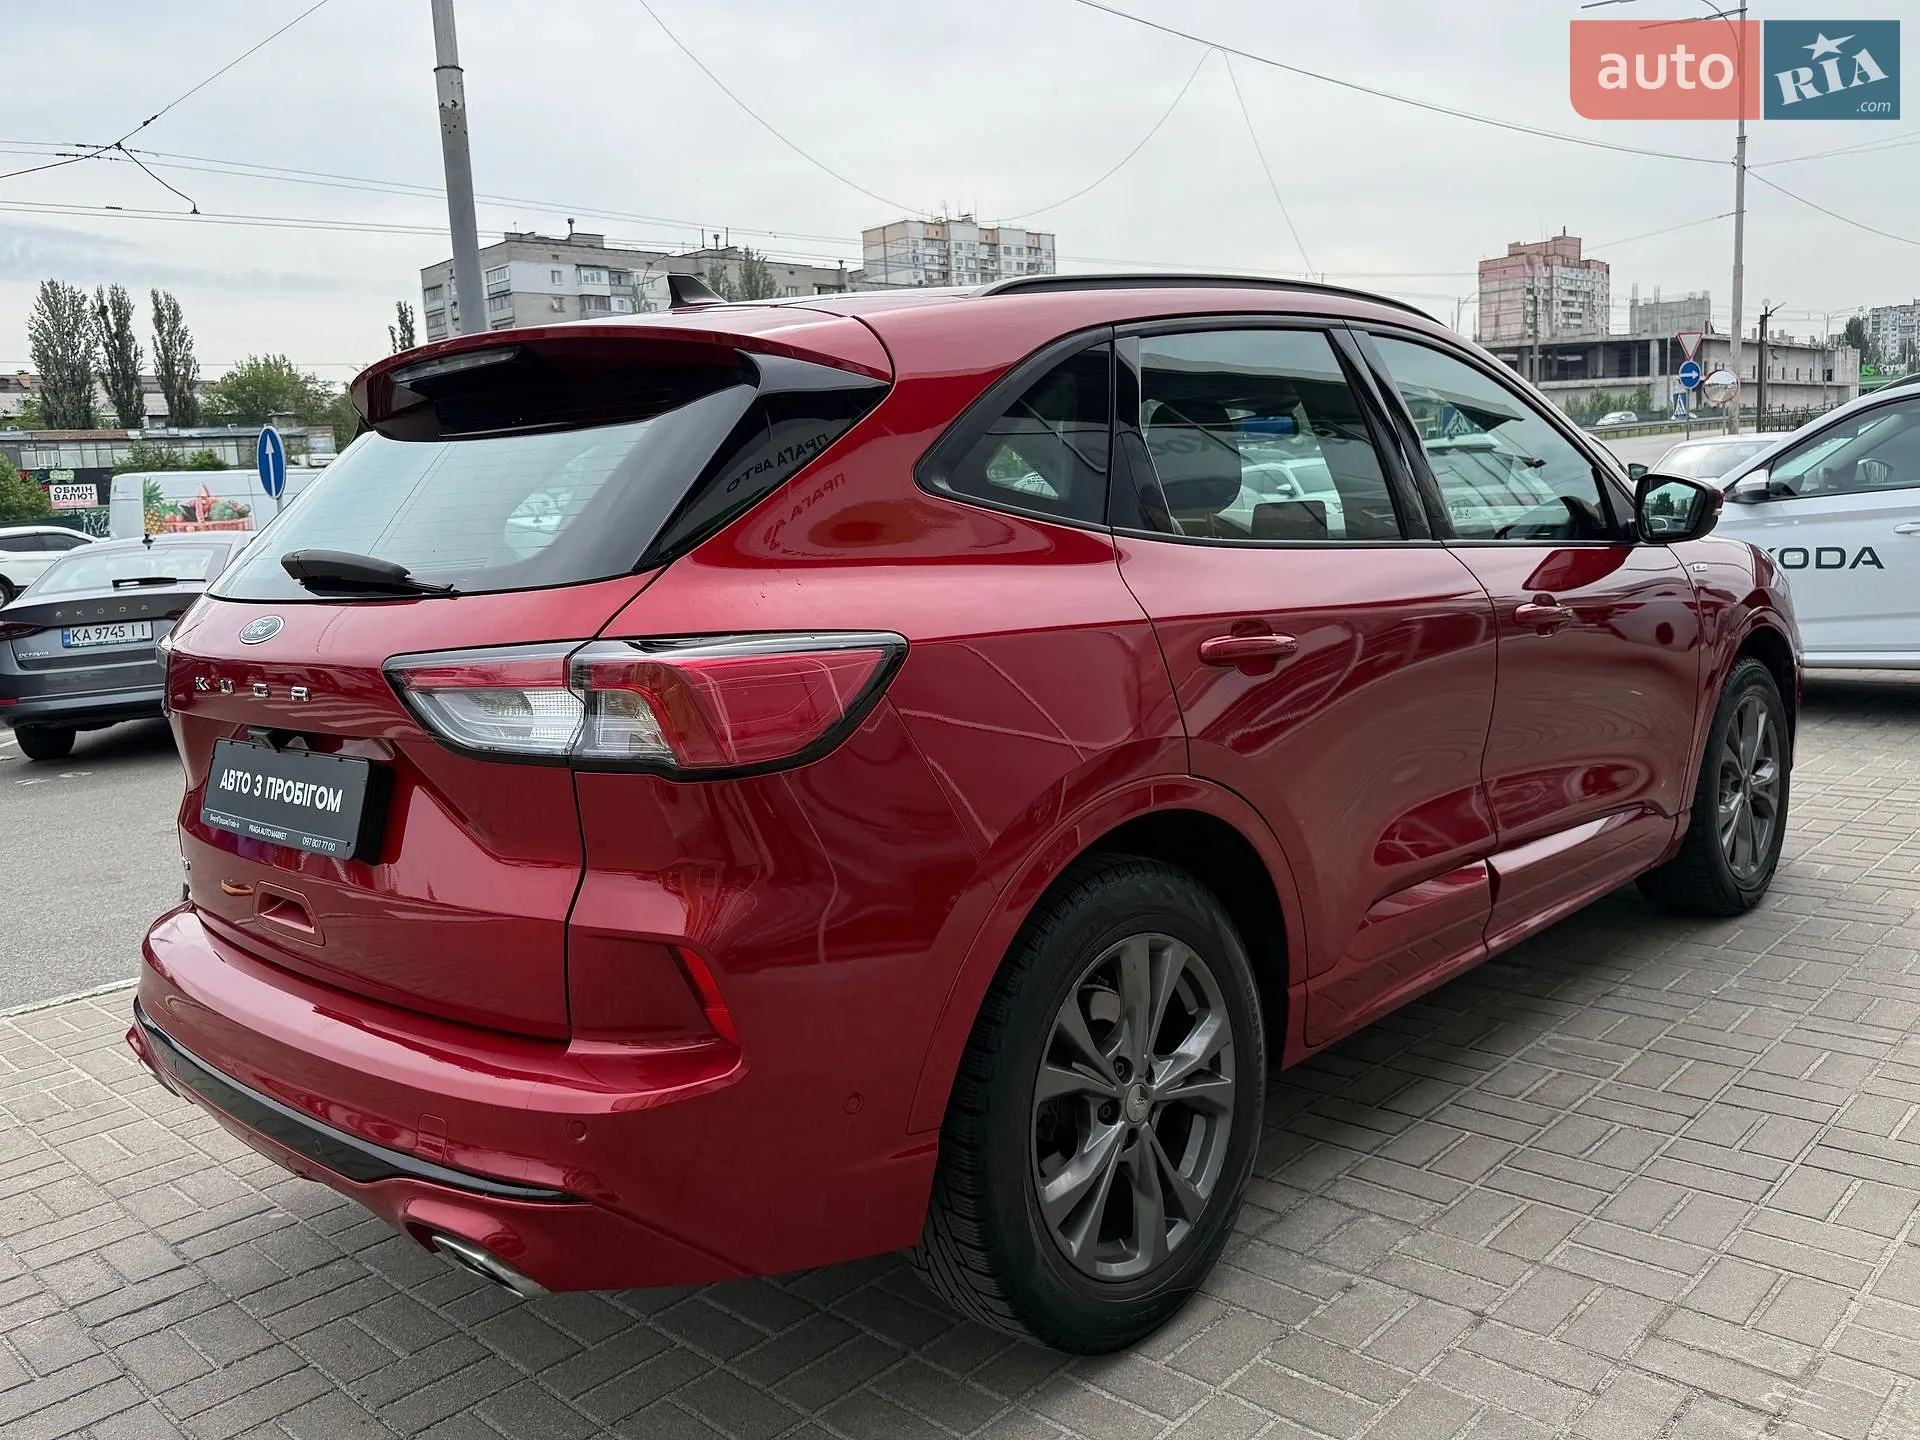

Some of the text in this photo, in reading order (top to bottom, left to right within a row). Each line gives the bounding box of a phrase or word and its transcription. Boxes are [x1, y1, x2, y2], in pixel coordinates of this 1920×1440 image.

[54, 485, 93, 494] ОБМІН
[53, 492, 94, 501] ВАЛЮТ
[71, 628, 92, 642] KA
[95, 625, 126, 640] 9745
[195, 676, 311, 702] KUGA
[219, 768, 252, 795] АВТО
[265, 776, 343, 813] ПРОБІГОМ
[302, 836, 312, 846] 097
